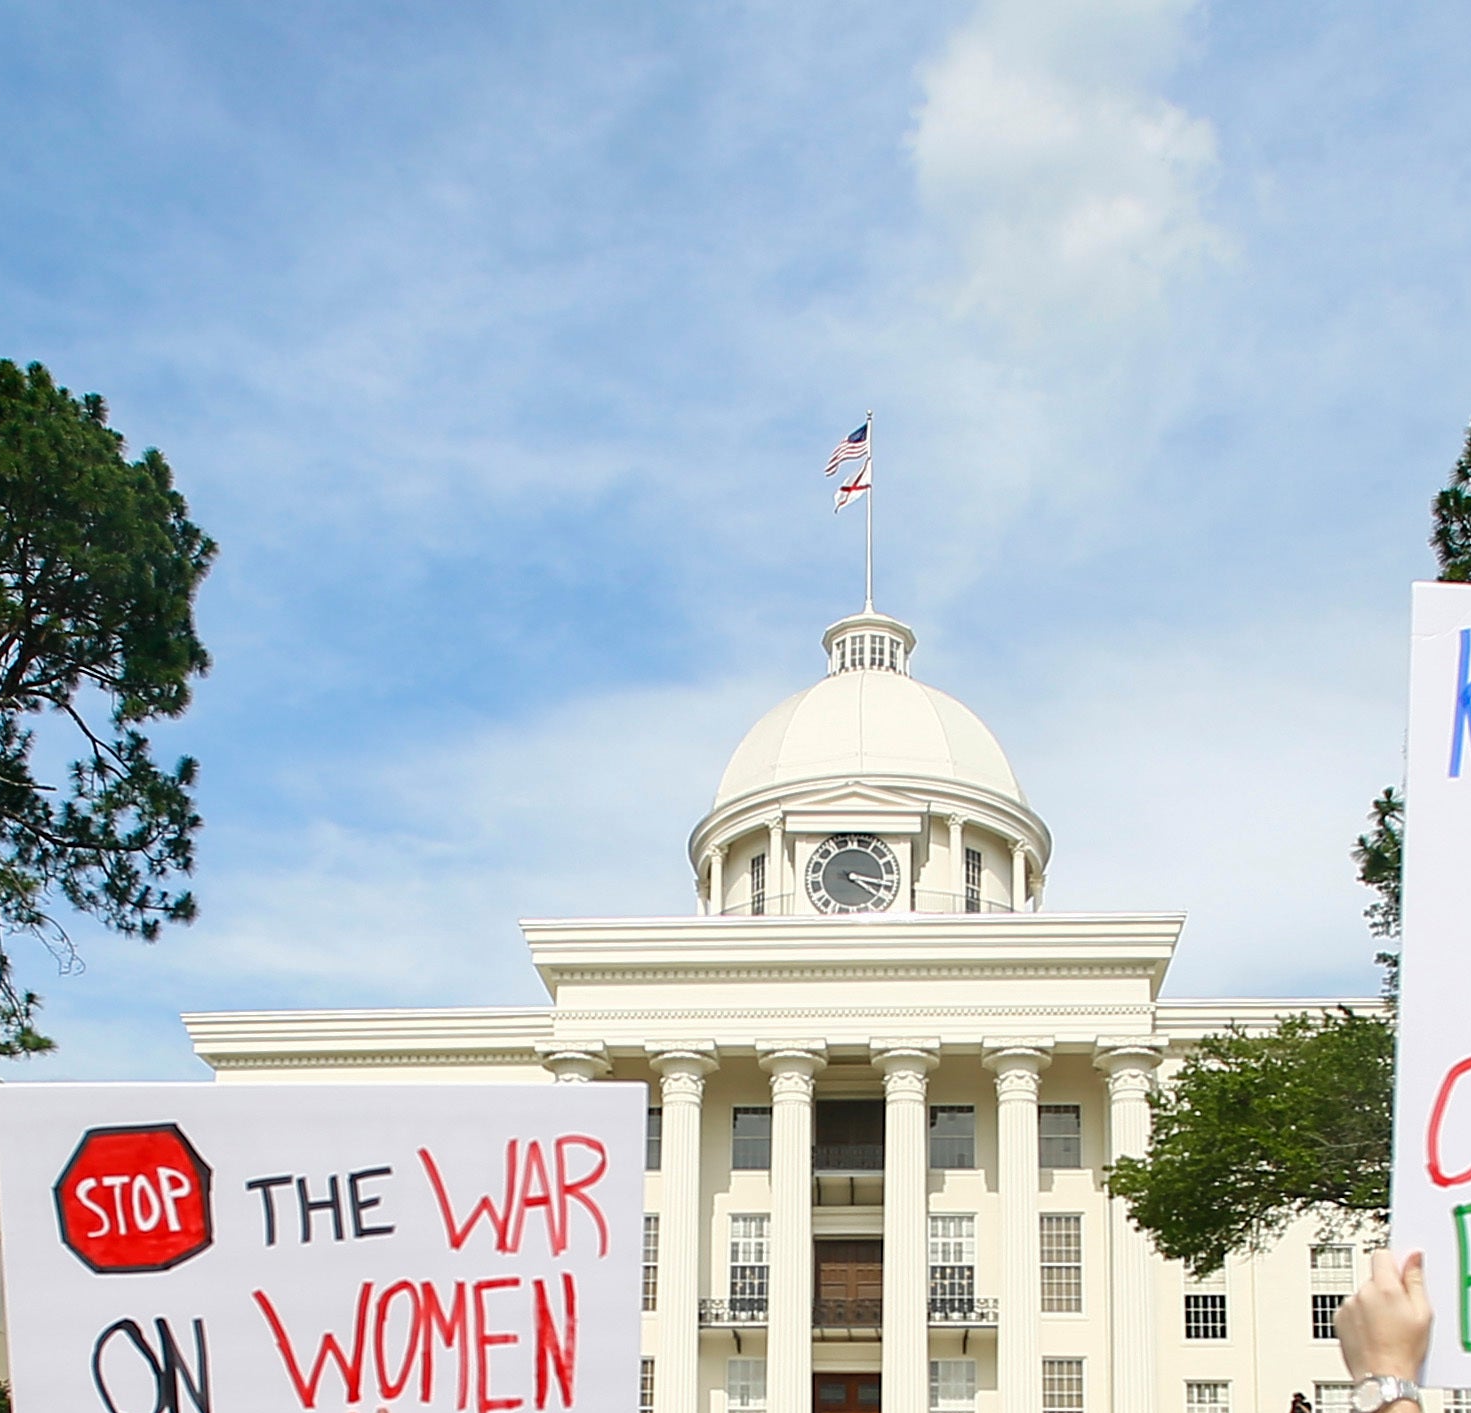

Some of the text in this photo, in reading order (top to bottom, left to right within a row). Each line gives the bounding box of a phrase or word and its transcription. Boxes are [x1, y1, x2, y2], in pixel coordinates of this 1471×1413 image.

[76, 1134, 609, 1258] STOP THE WAR
